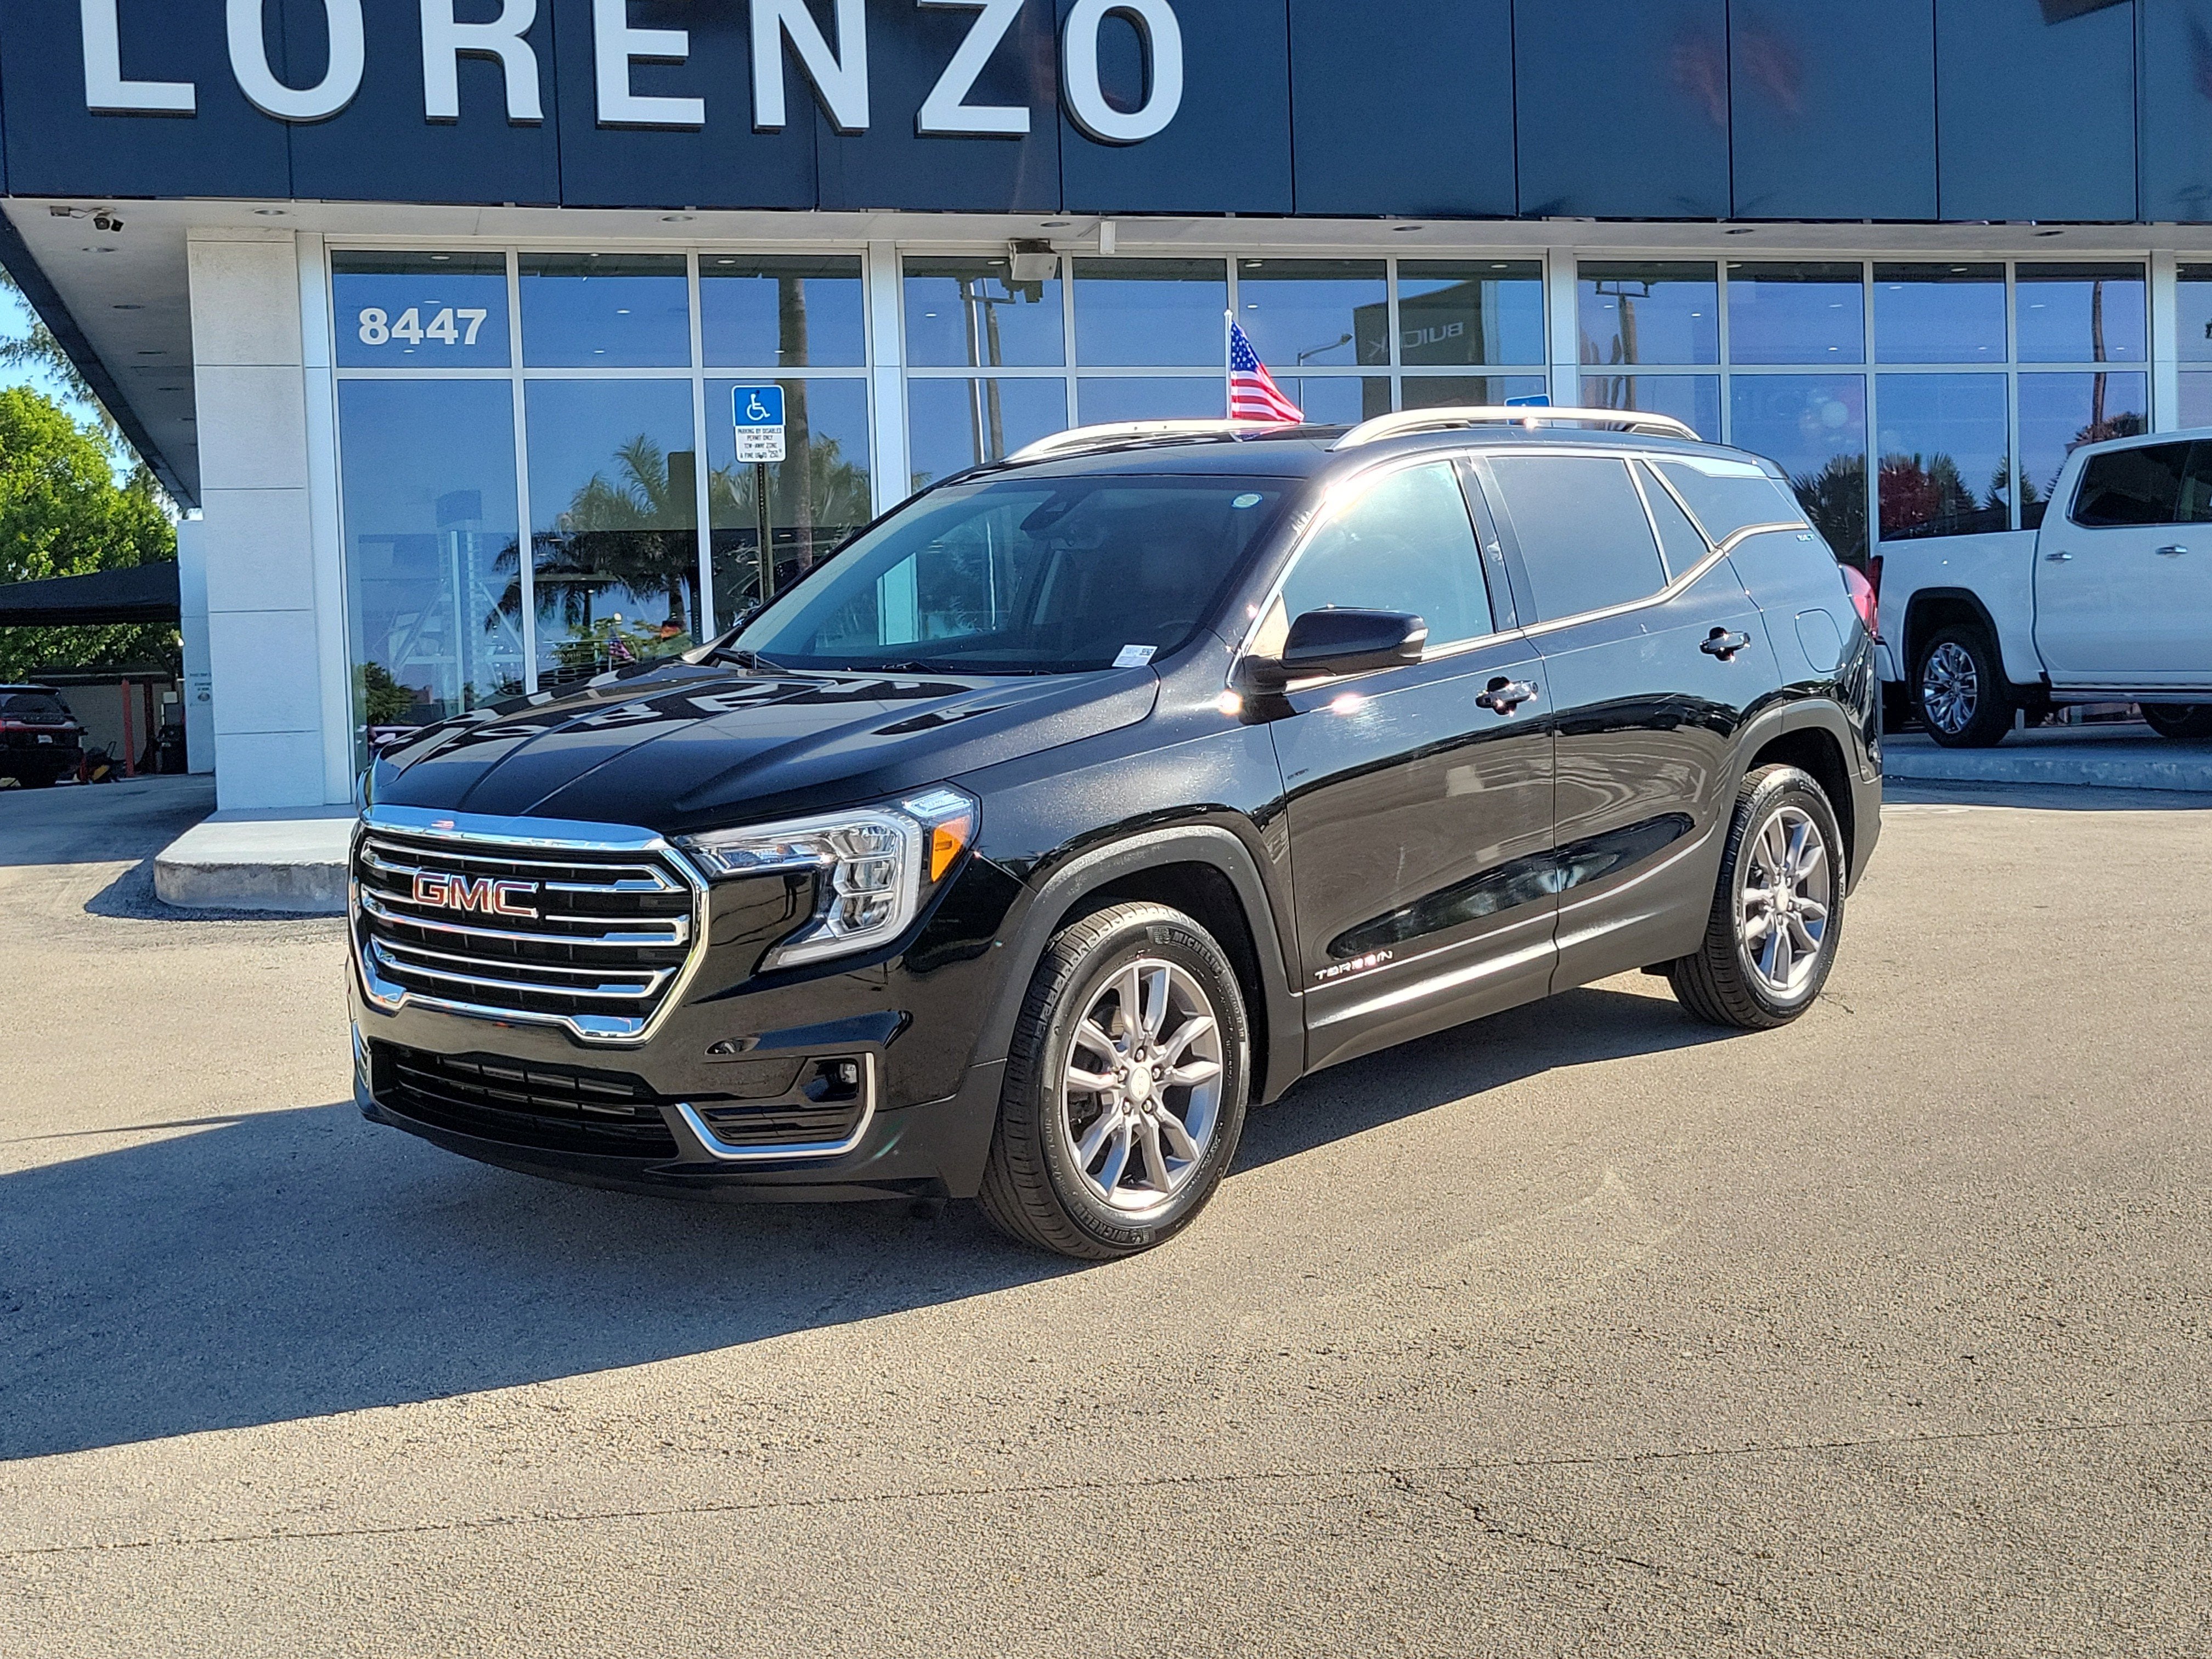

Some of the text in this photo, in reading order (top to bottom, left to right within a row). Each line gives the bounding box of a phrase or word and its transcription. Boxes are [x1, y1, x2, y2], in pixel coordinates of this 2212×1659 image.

[81, 0, 1184, 144] LORENZO
[359, 307, 487, 345] 8447
[413, 871, 539, 919] GMC
[1172, 930, 1223, 977] MICHELIN
[1072, 1203, 1132, 1242] MICHELIN
